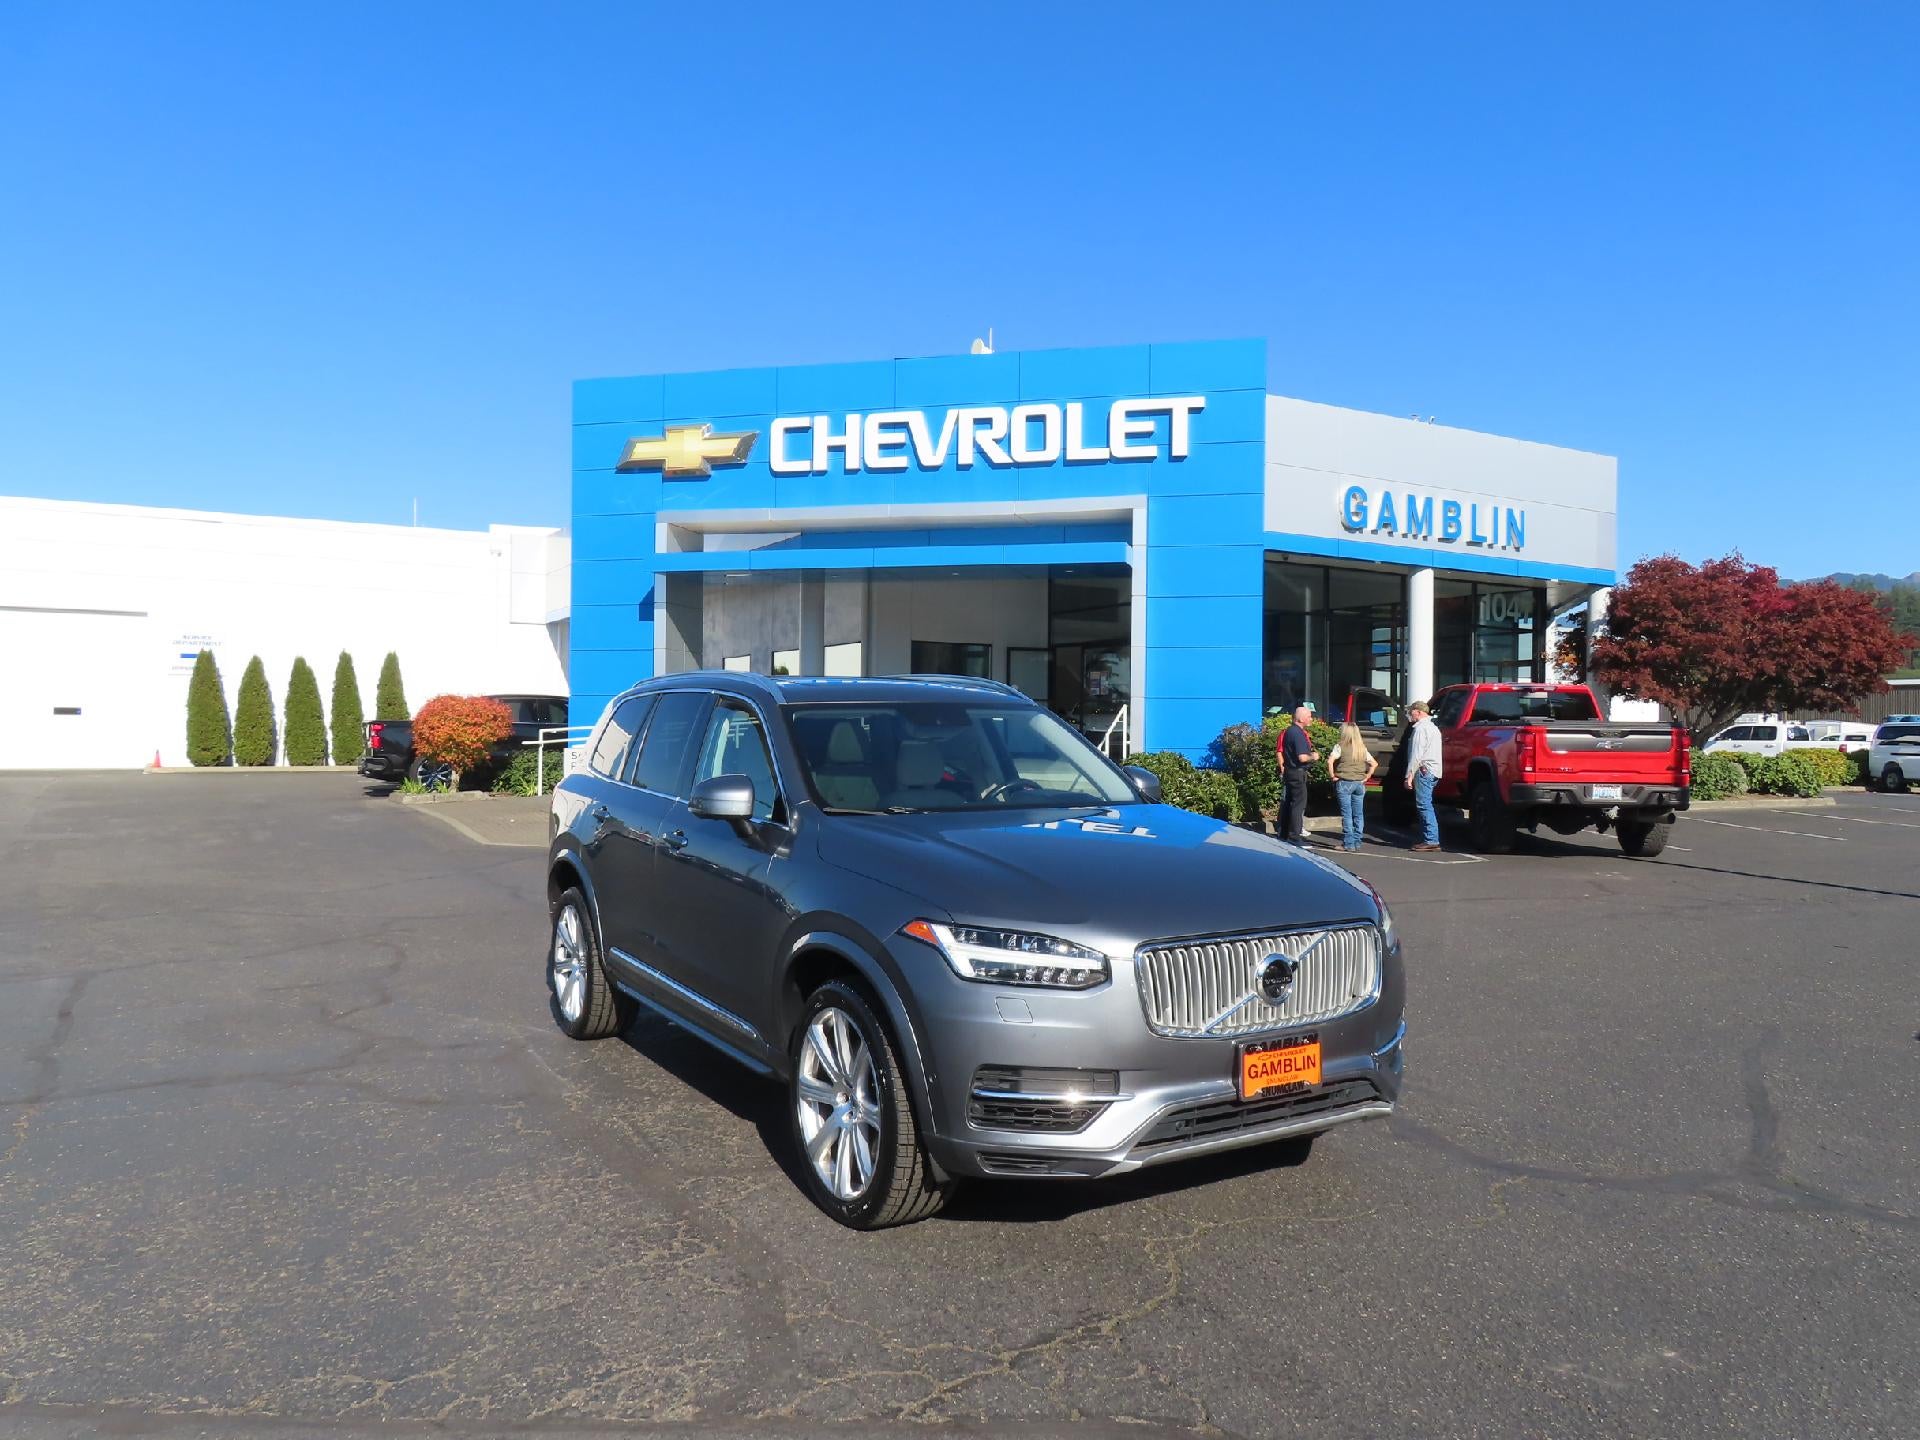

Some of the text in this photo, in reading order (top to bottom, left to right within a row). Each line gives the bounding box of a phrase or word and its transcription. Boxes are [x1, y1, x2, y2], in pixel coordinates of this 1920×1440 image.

[769, 396, 1206, 473] CHEVROLET
[1342, 485, 1525, 549] GAMBLIN
[1480, 594, 1530, 623] 104
[1248, 1054, 1316, 1079] GAMBLIN
